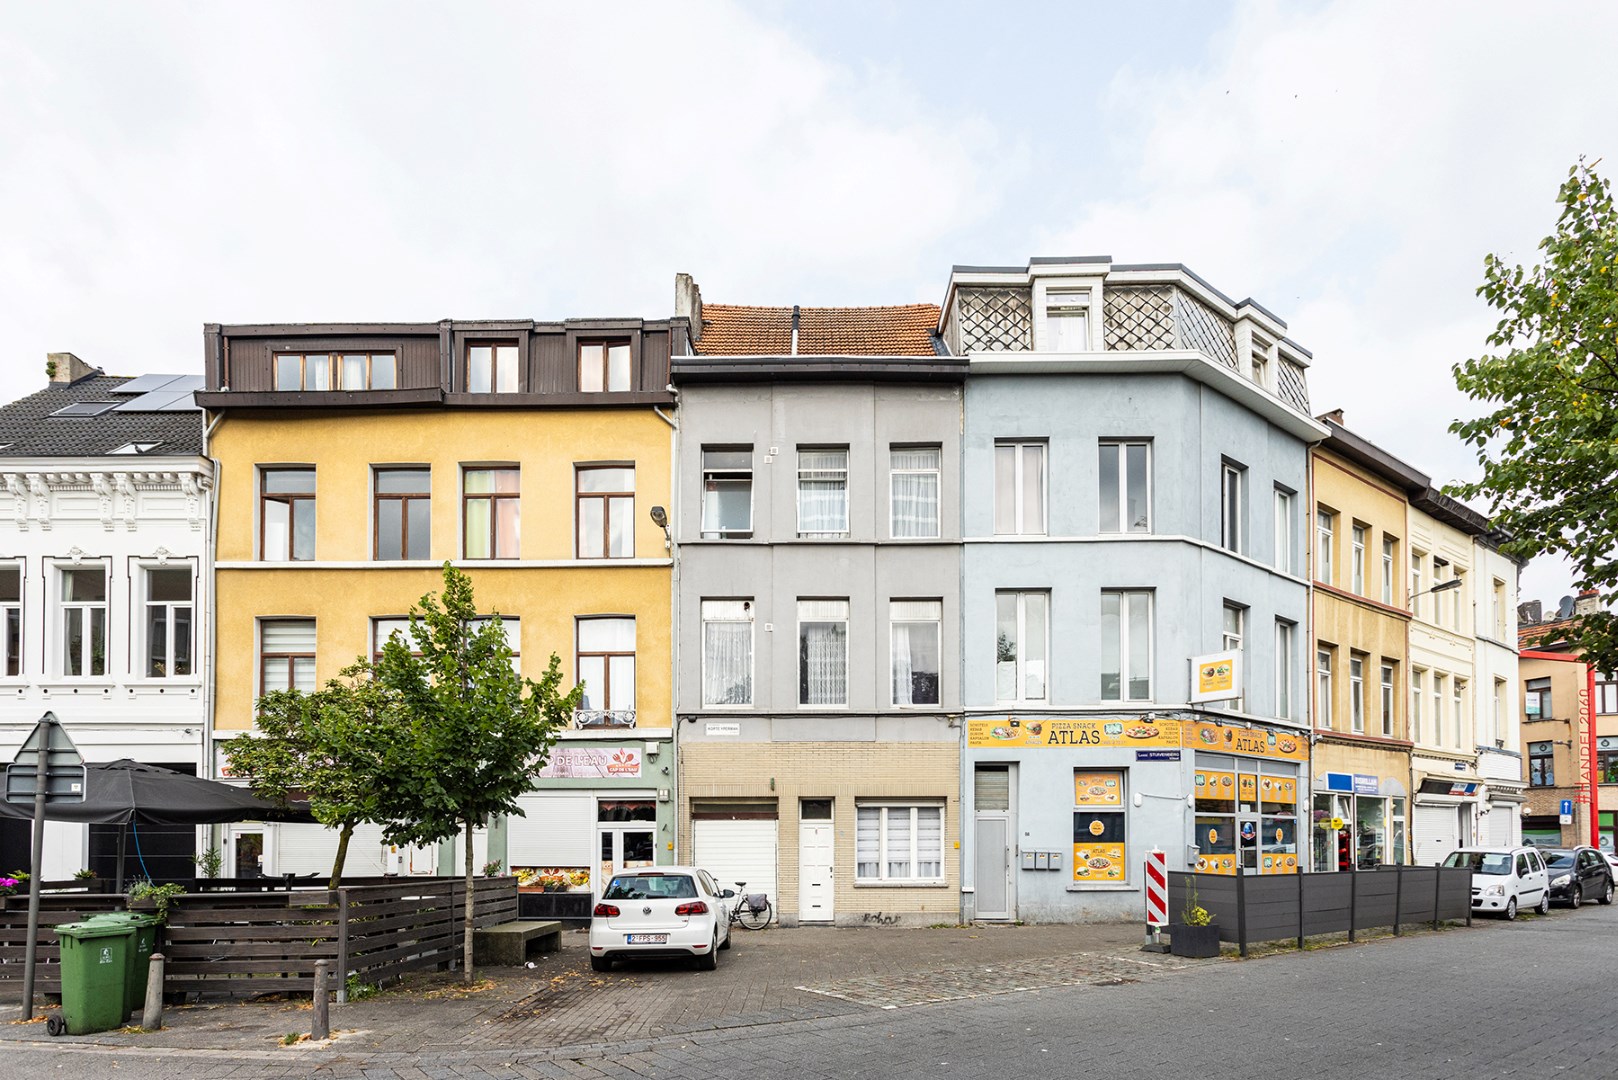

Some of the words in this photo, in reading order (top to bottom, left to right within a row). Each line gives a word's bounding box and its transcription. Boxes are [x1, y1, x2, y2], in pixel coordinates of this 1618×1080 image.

[1048, 730, 1100, 745] ATLAS
[1235, 738, 1265, 753] ATLAS
[557, 756, 572, 766] DE
[574, 755, 608, 767] L'EAU
